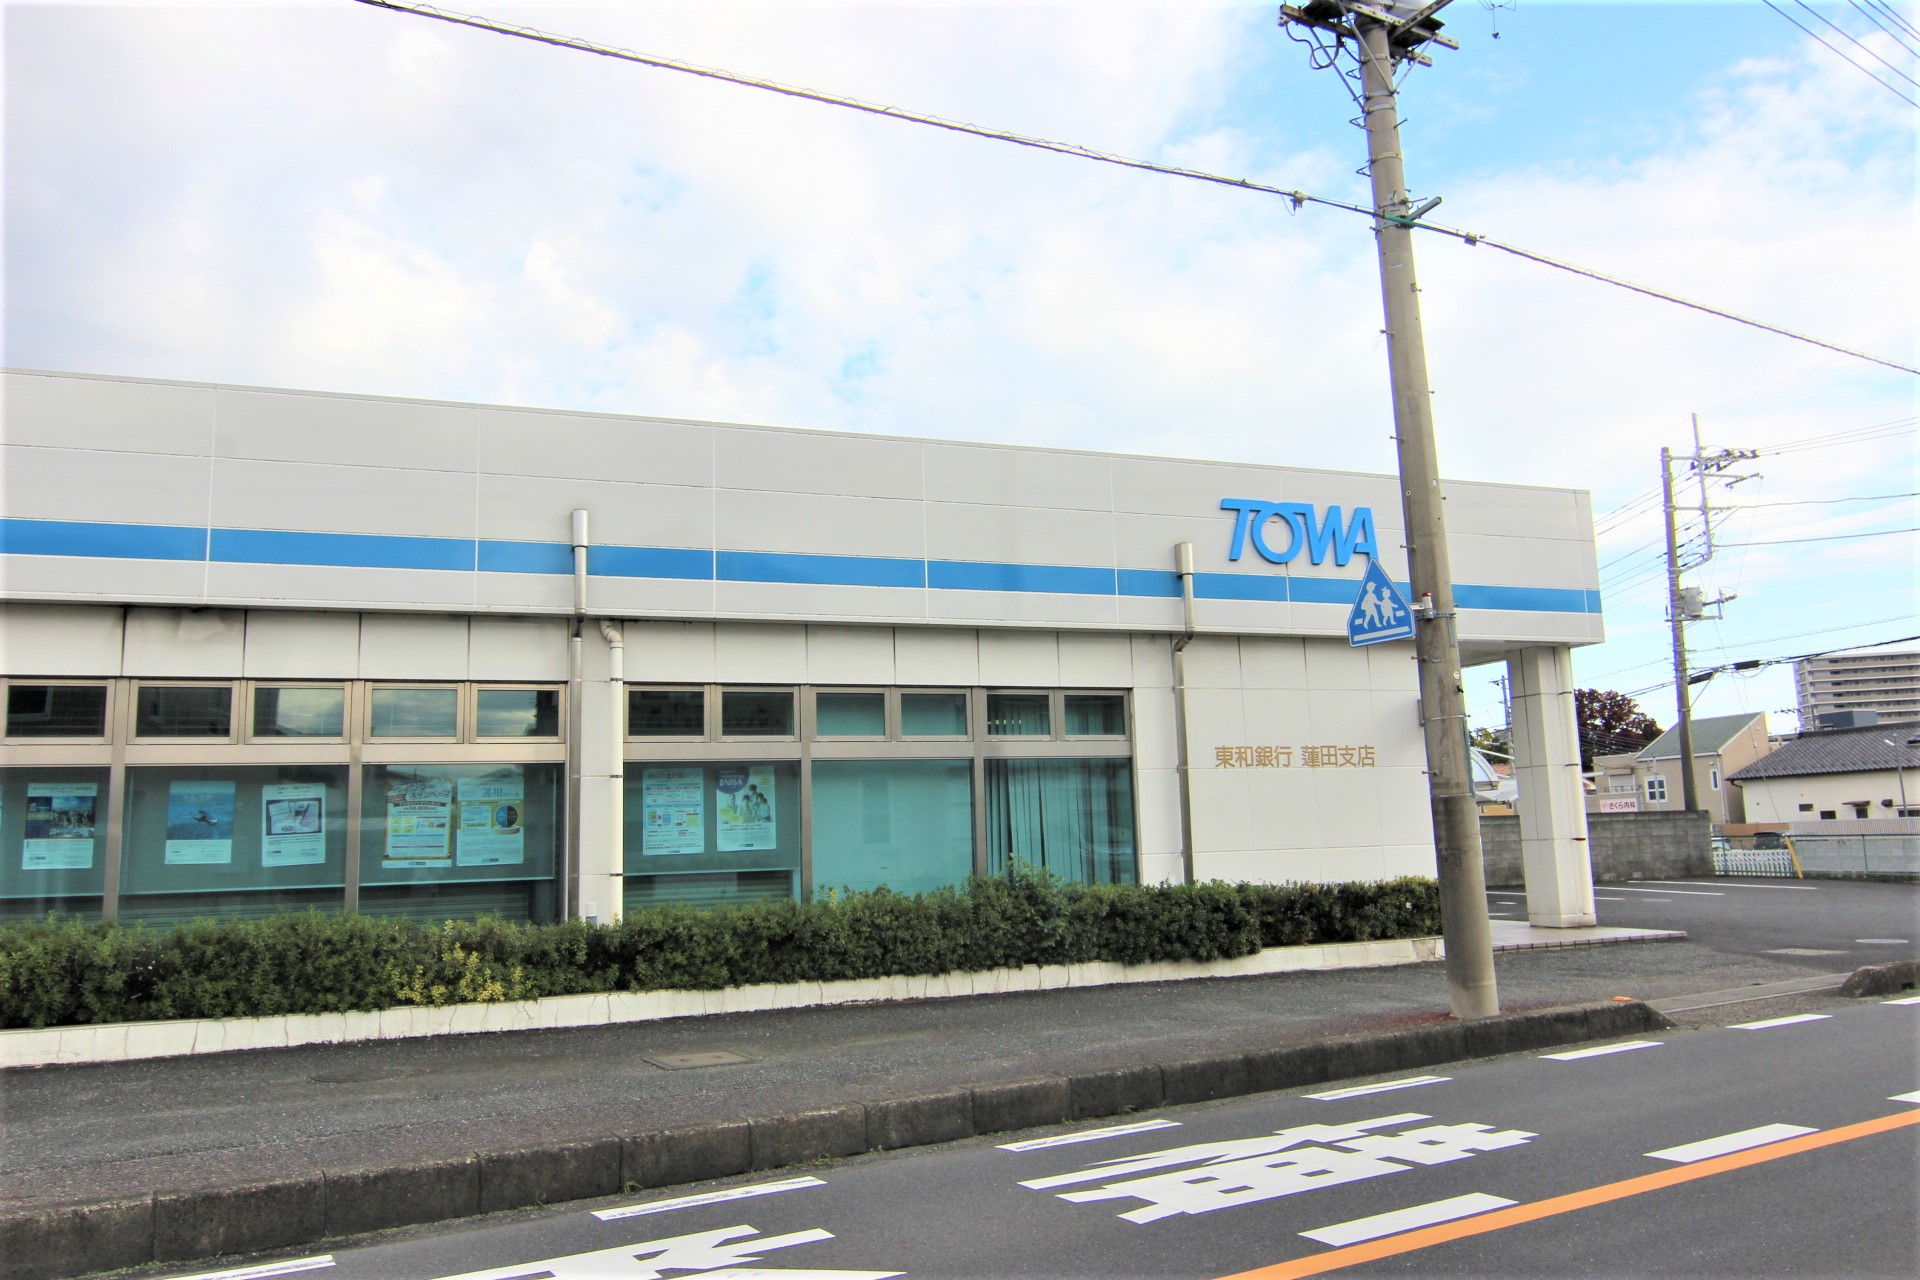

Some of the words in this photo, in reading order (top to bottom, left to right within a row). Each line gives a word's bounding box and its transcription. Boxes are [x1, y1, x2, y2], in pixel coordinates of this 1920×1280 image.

[1220, 498, 1379, 568] TOWA
[1214, 745, 1293, 768] 東和銀行
[1300, 744, 1375, 768] 蓮田支店
[1609, 801, 1636, 809] さくら内科
